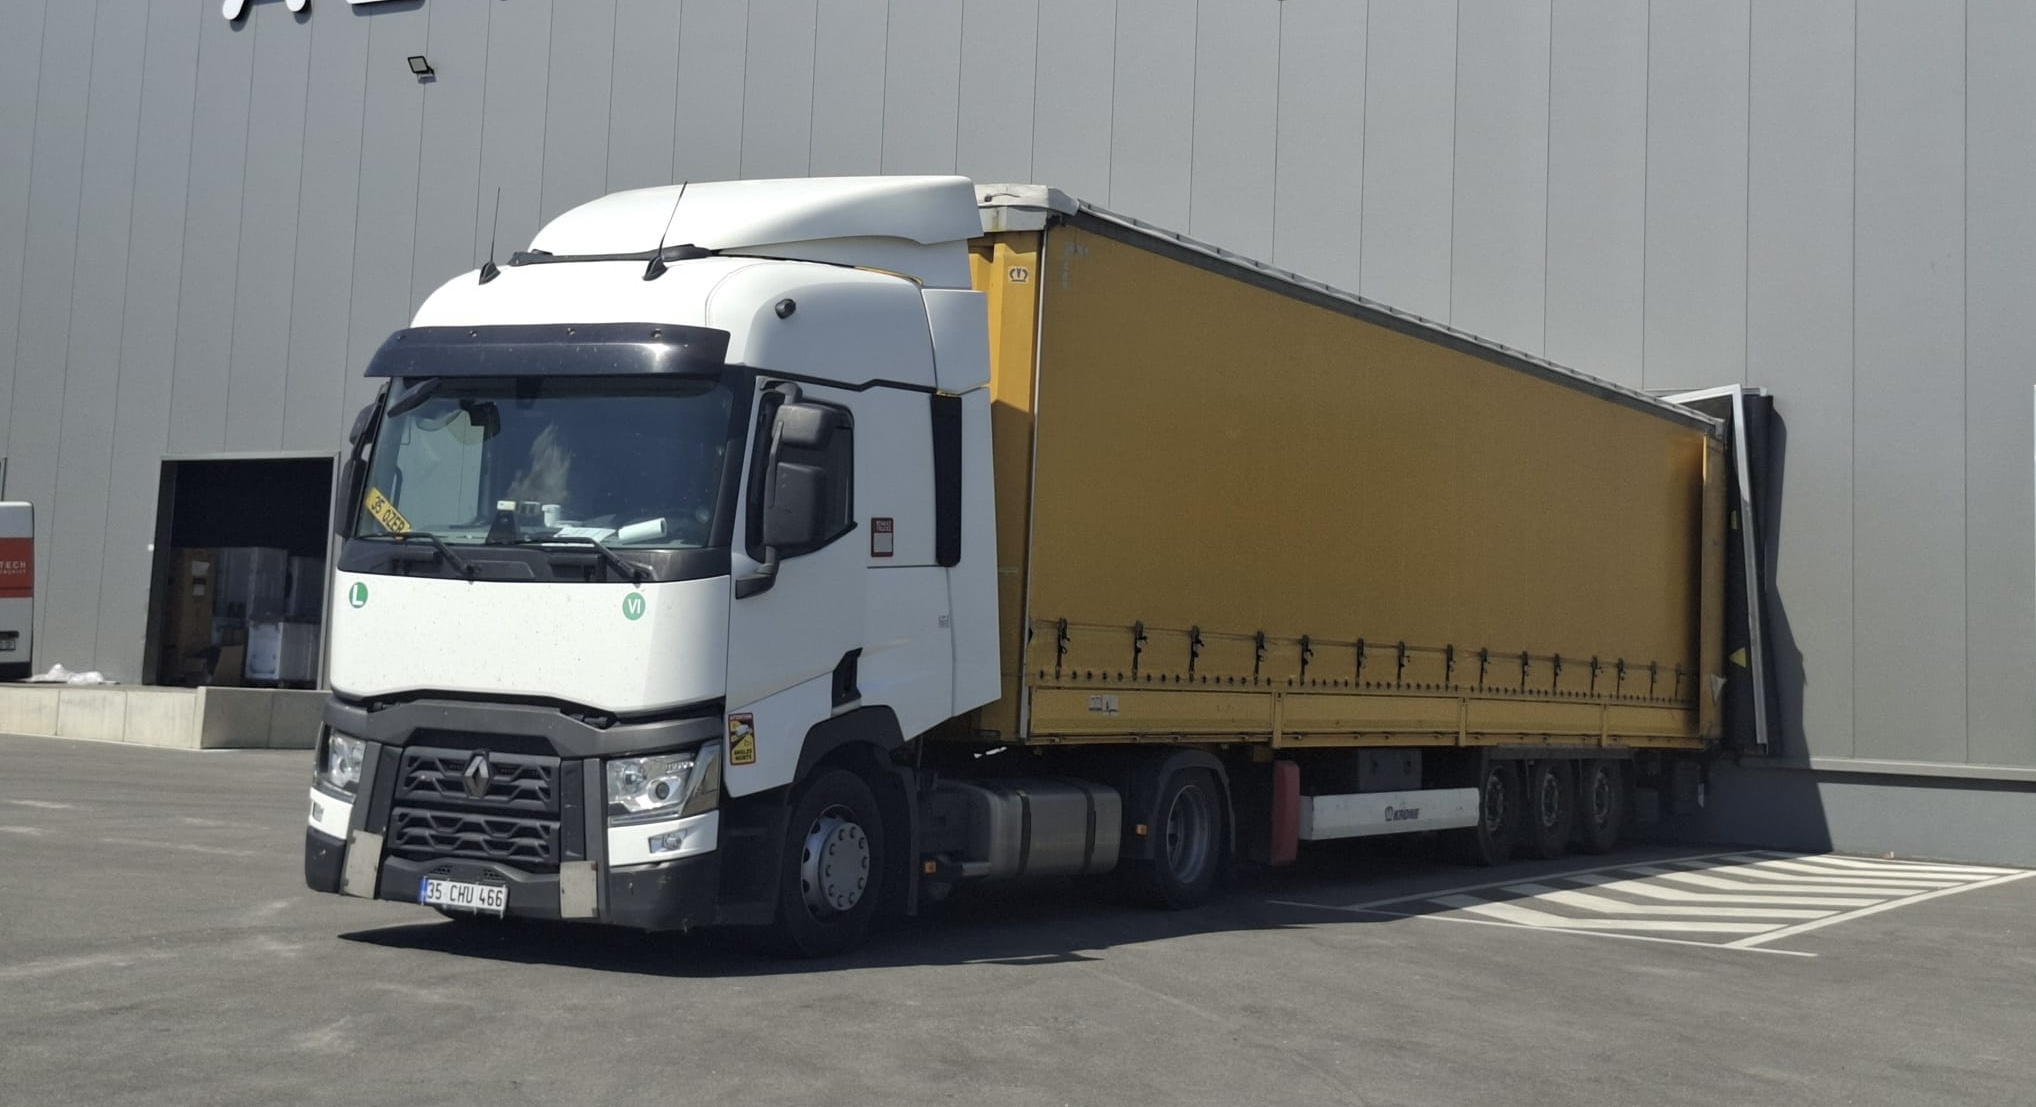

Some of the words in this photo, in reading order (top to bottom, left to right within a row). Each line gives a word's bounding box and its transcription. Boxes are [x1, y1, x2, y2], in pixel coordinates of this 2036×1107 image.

[371, 495, 386, 514] 35
[352, 584, 364, 605] L
[627, 598, 641, 614] VI
[427, 881, 442, 900] 35
[449, 884, 475, 904] CHU
[479, 887, 503, 907] 466
